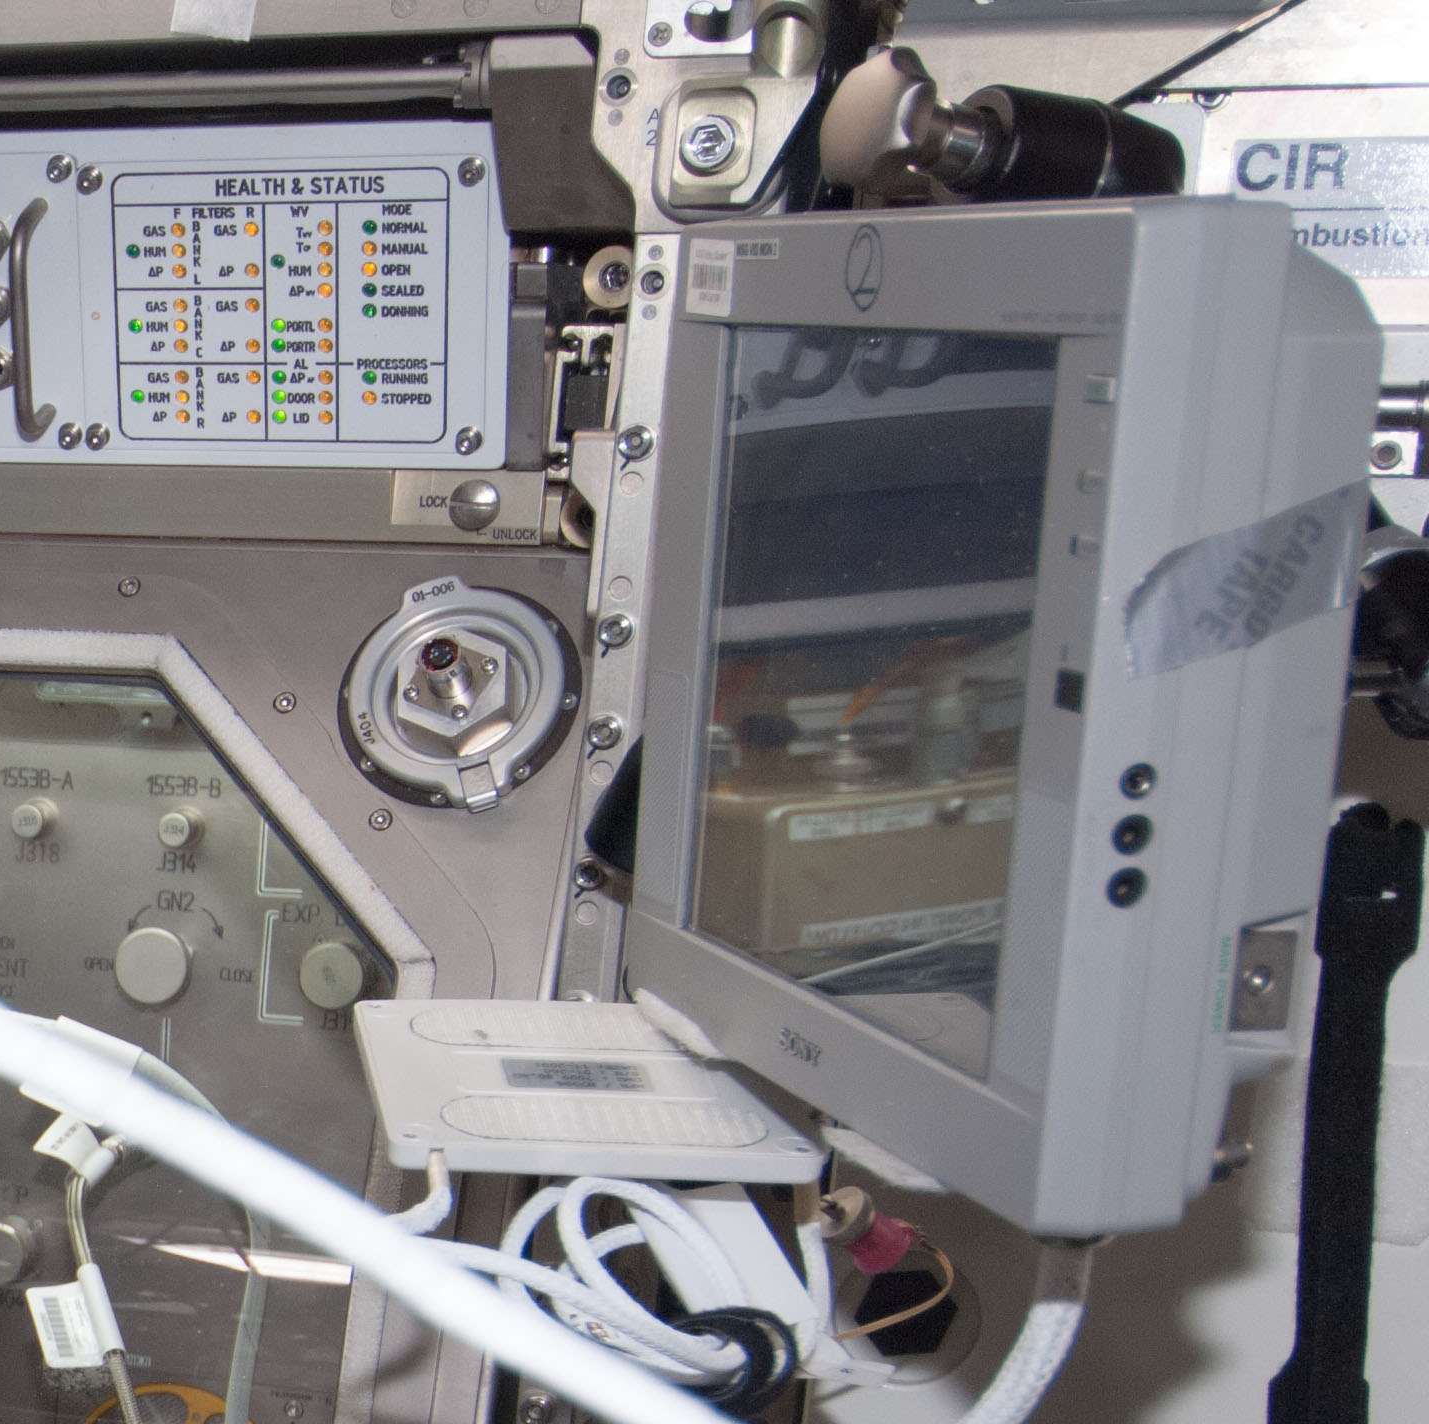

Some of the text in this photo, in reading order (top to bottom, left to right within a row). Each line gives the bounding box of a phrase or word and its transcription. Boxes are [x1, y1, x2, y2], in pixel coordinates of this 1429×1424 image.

[1236, 142, 1350, 192] CIR
[214, 174, 385, 198] HEALTH & STATUS
[191, 206, 236, 219] FILTERS
[382, 204, 412, 216] MODE
[143, 225, 166, 237] GAS
[214, 224, 237, 236] GAS
[381, 222, 428, 234] NORMAL
[143, 245, 167, 258] HUM
[381, 243, 428, 255] MANUAL
[288, 265, 312, 277] HUM
[381, 264, 411, 276] OPEN
[381, 284, 425, 297] SEALED
[145, 301, 168, 313] GAS
[215, 300, 239, 312] GAS
[381, 305, 429, 317] DONNING
[146, 320, 169, 333] HUM
[356, 358, 428, 370] PROCESSORS
[147, 372, 170, 383] GAS
[217, 372, 240, 383] GAS
[381, 373, 428, 384] RUNNING
[148, 391, 171, 403] HUM
[287, 393, 316, 405] DOOR
[381, 393, 432, 405] STOPPED
[292, 412, 310, 425] LID
[419, 495, 449, 509] LOCK
[411, 580, 456, 604] 01-006
[357, 711, 377, 745] J404
[0, 766, 75, 792] 1553B-A
[145, 773, 222, 799] 1553B-B
[156, 851, 197, 873] J314
[156, 889, 196, 912] GN2
